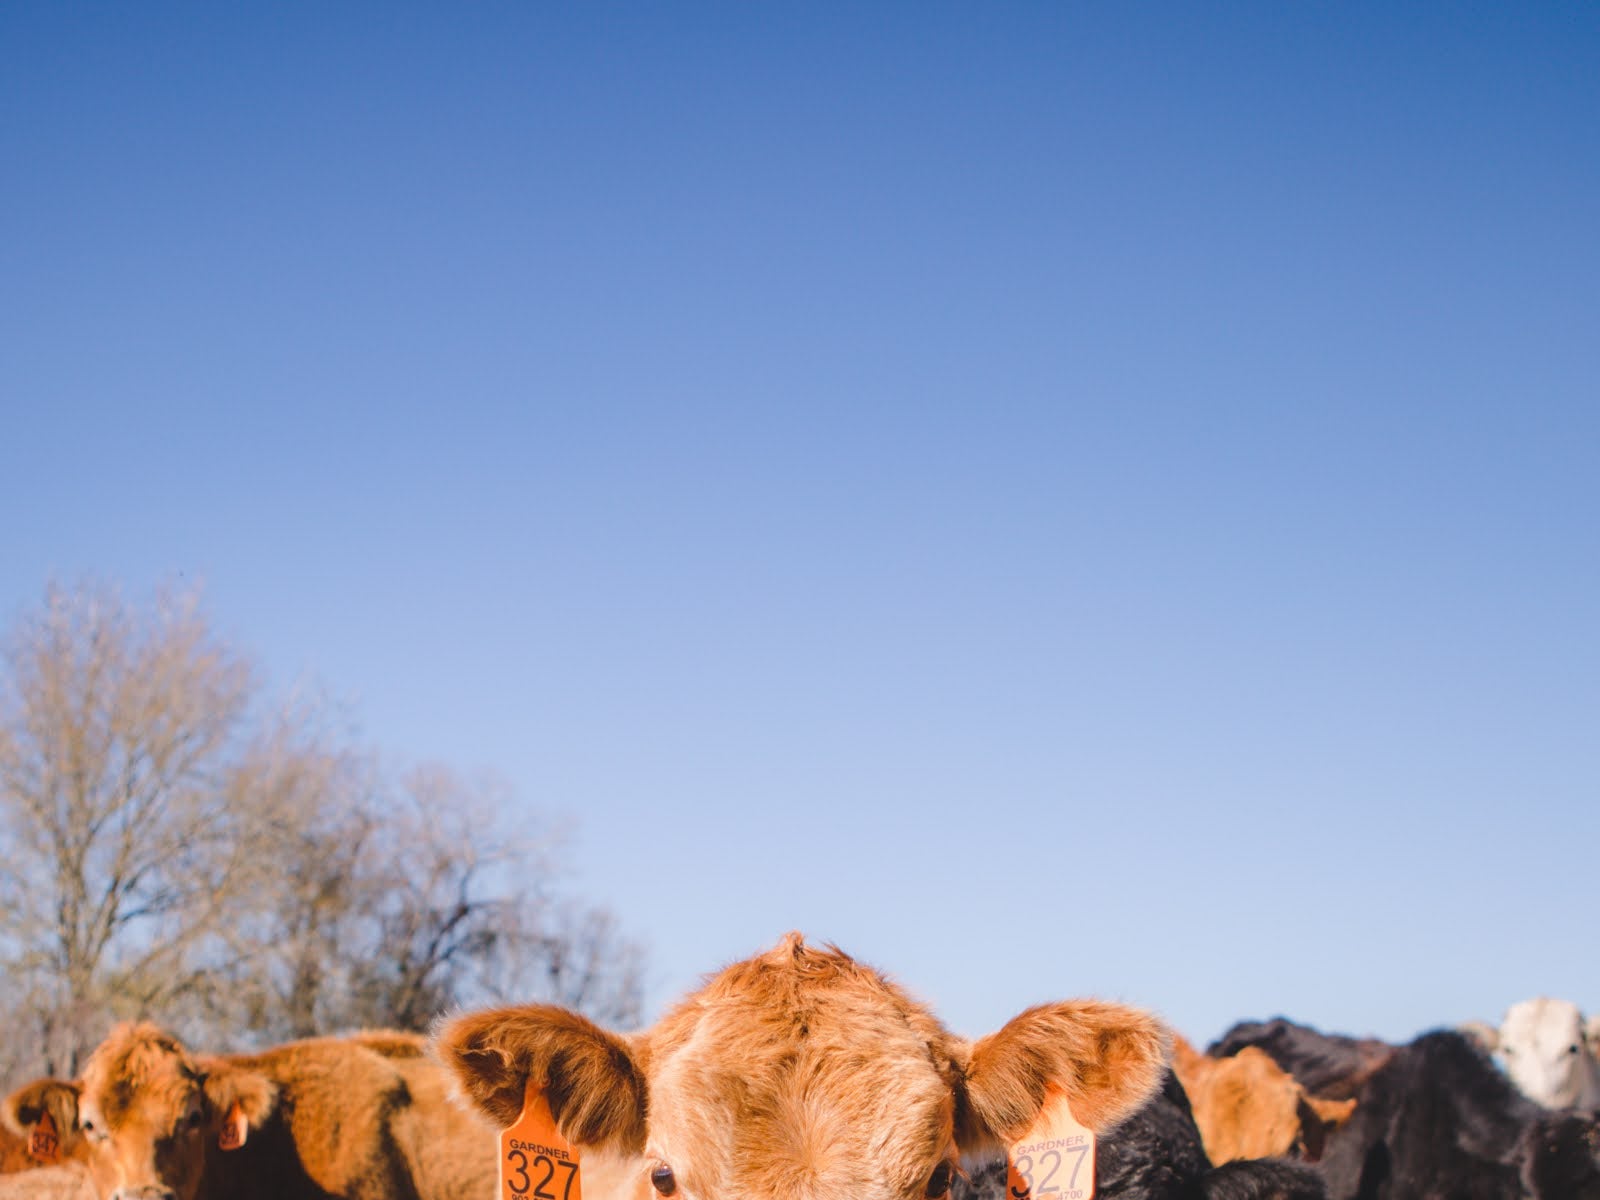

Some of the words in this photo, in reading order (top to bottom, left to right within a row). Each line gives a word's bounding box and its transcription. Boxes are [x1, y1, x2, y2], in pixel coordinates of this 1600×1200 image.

[509, 1139, 570, 1160] GARDNER
[1016, 1135, 1085, 1156] GARDNER
[1011, 1144, 1090, 1198] 327
